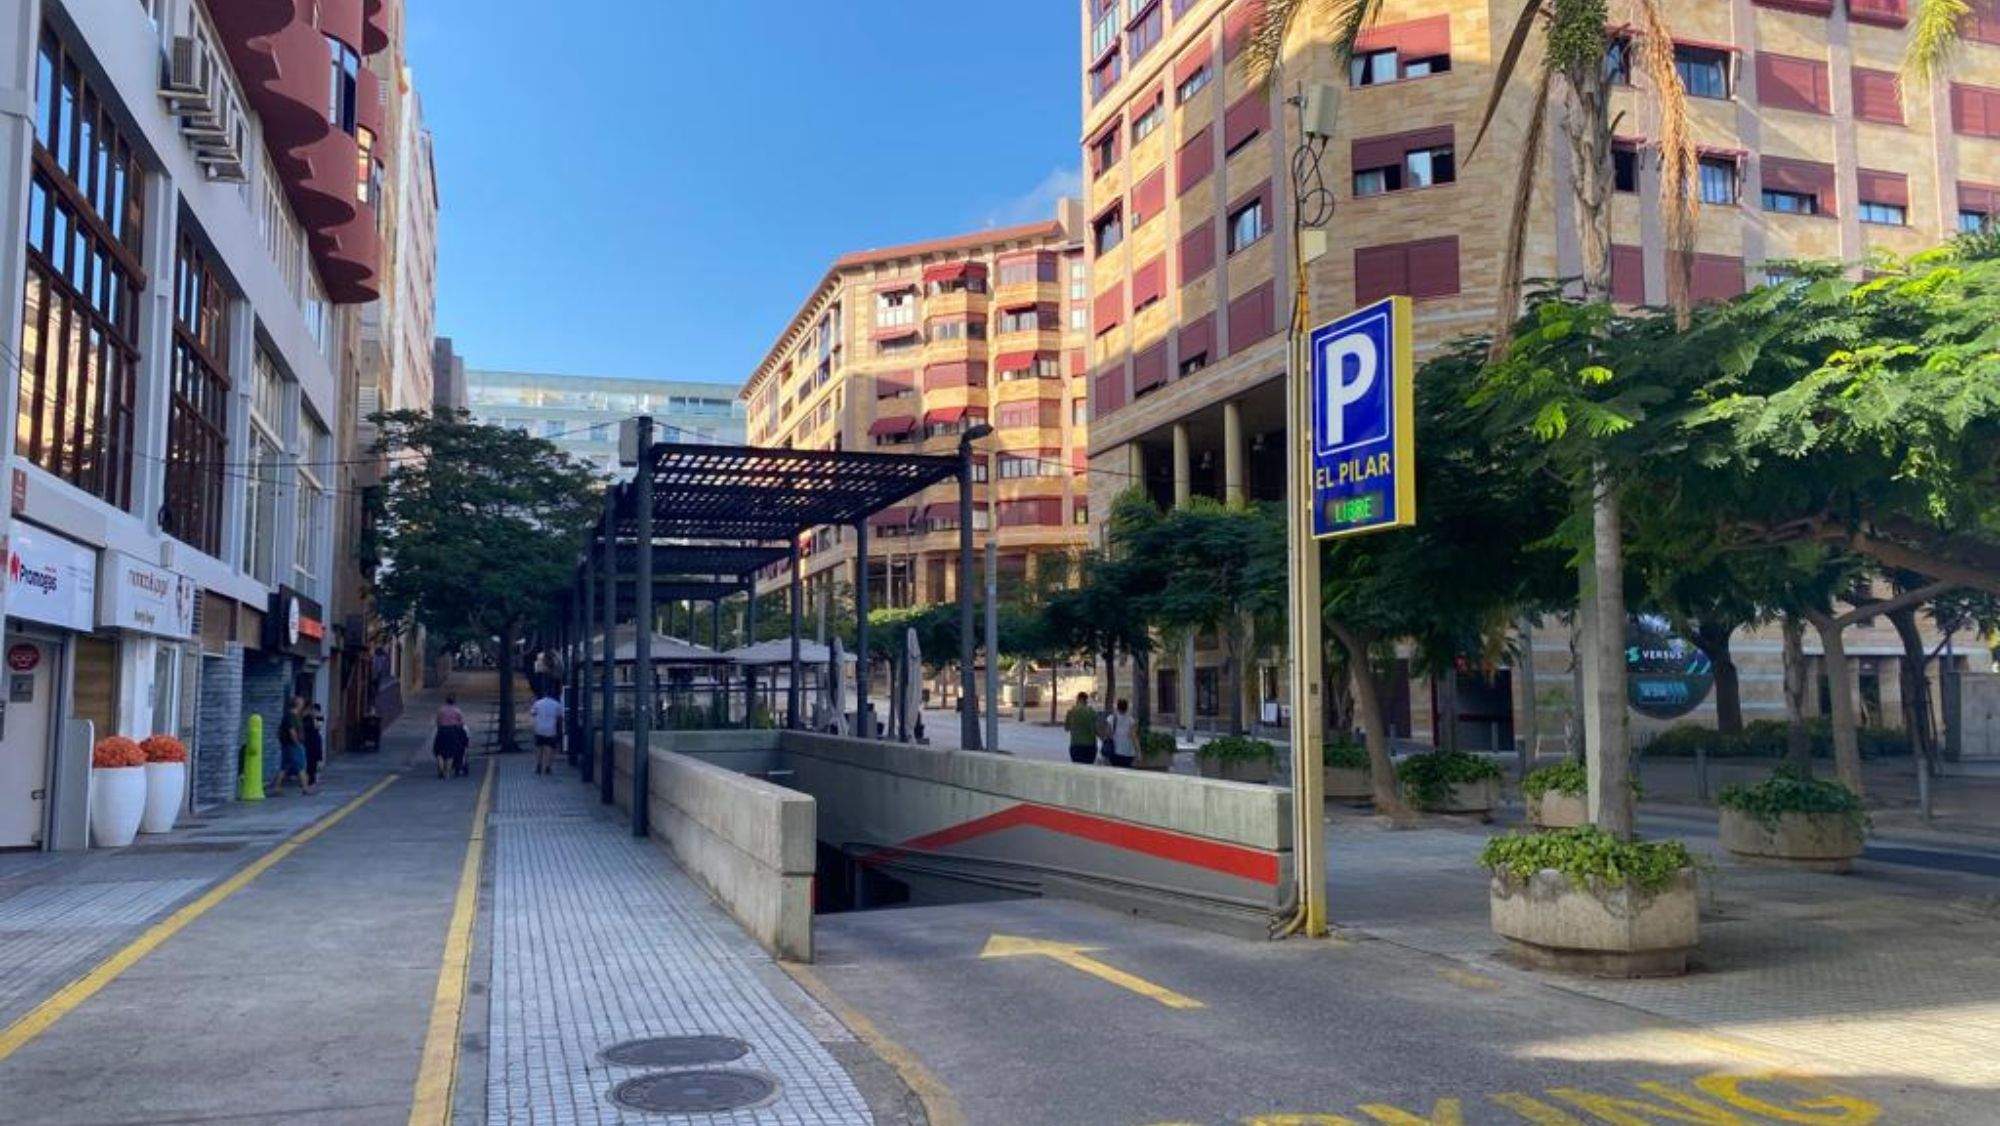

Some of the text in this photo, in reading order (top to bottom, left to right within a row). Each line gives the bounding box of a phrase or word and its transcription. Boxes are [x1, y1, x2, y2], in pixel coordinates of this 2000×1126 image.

[1326, 333, 1378, 447] P
[1316, 452, 1391, 490] EL PILAR
[1335, 495, 1373, 523] LIBRE
